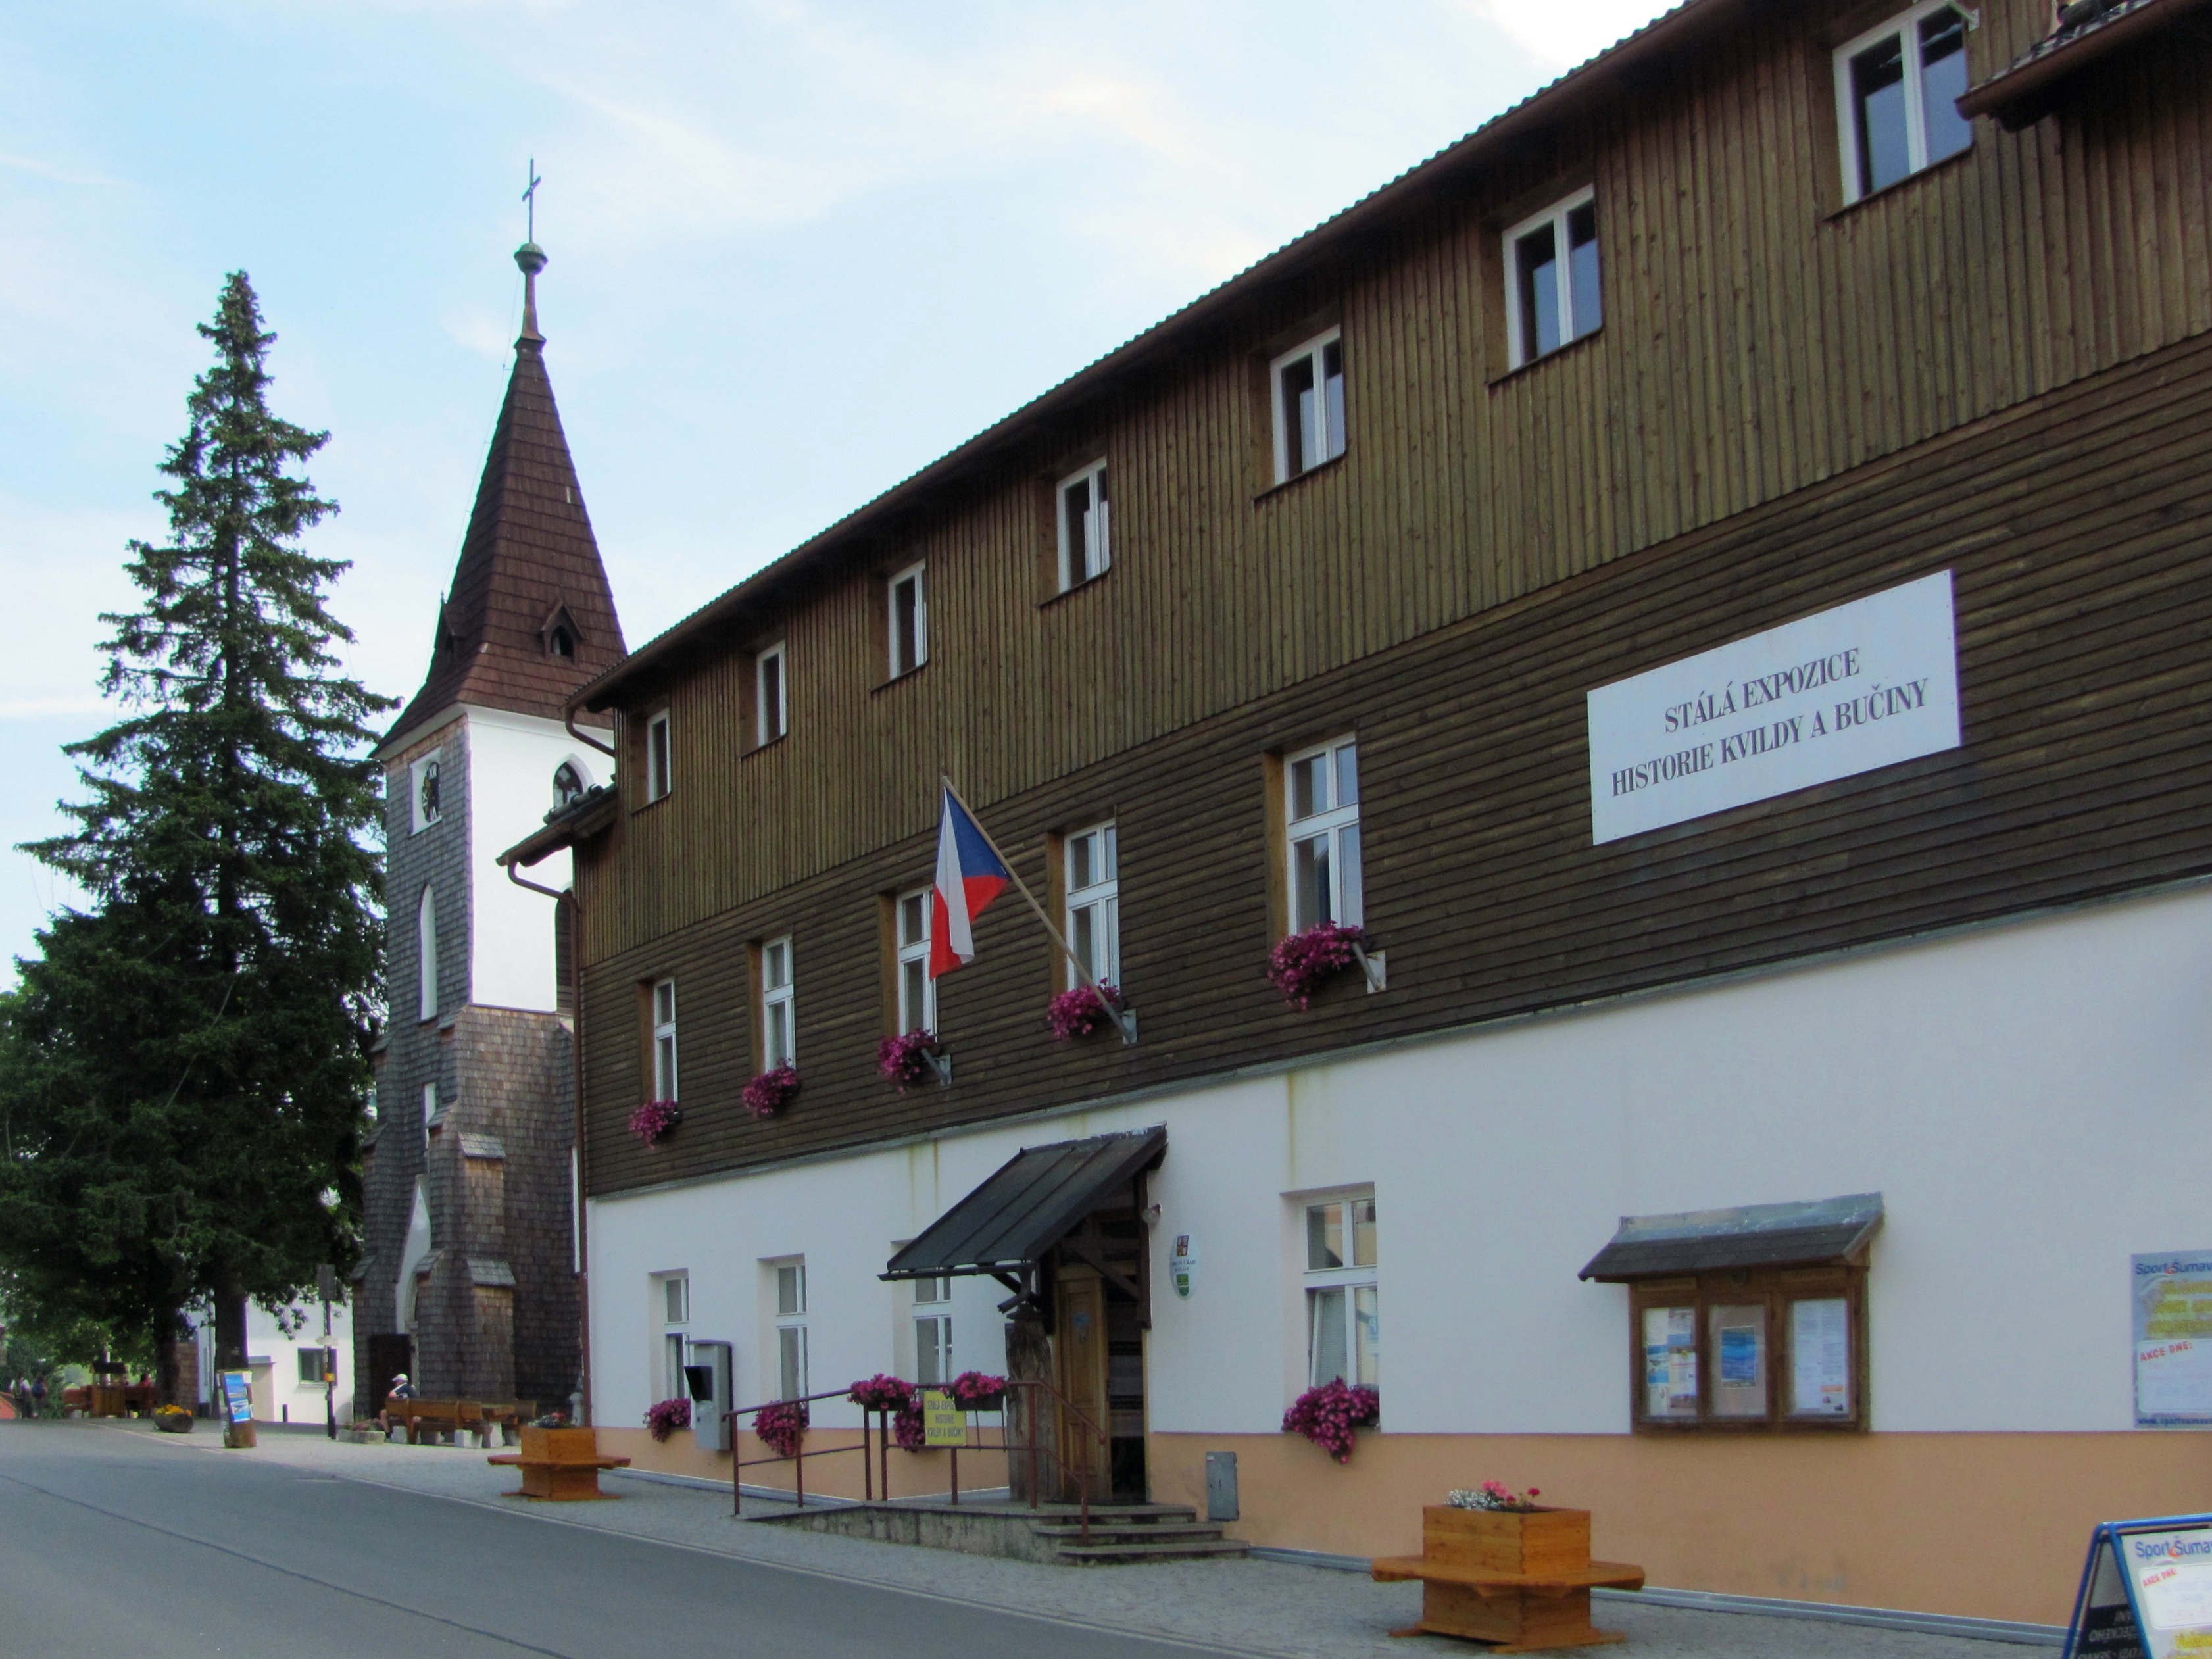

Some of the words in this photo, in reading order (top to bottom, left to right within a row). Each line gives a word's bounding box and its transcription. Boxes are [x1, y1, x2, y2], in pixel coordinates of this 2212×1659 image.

[1665, 681, 1736, 733] STÁLÁ
[1742, 647, 1860, 710] EXPOZICE
[1612, 743, 1713, 797] HISTORIE
[1720, 715, 1804, 764] KVILDY
[1810, 710, 1828, 739] A
[1834, 678, 1929, 730] BUČINY
[2136, 1262, 2168, 1275] Sport
[2140, 1348, 2165, 1362] AKCE
[2136, 1541, 2169, 1560] Sport
